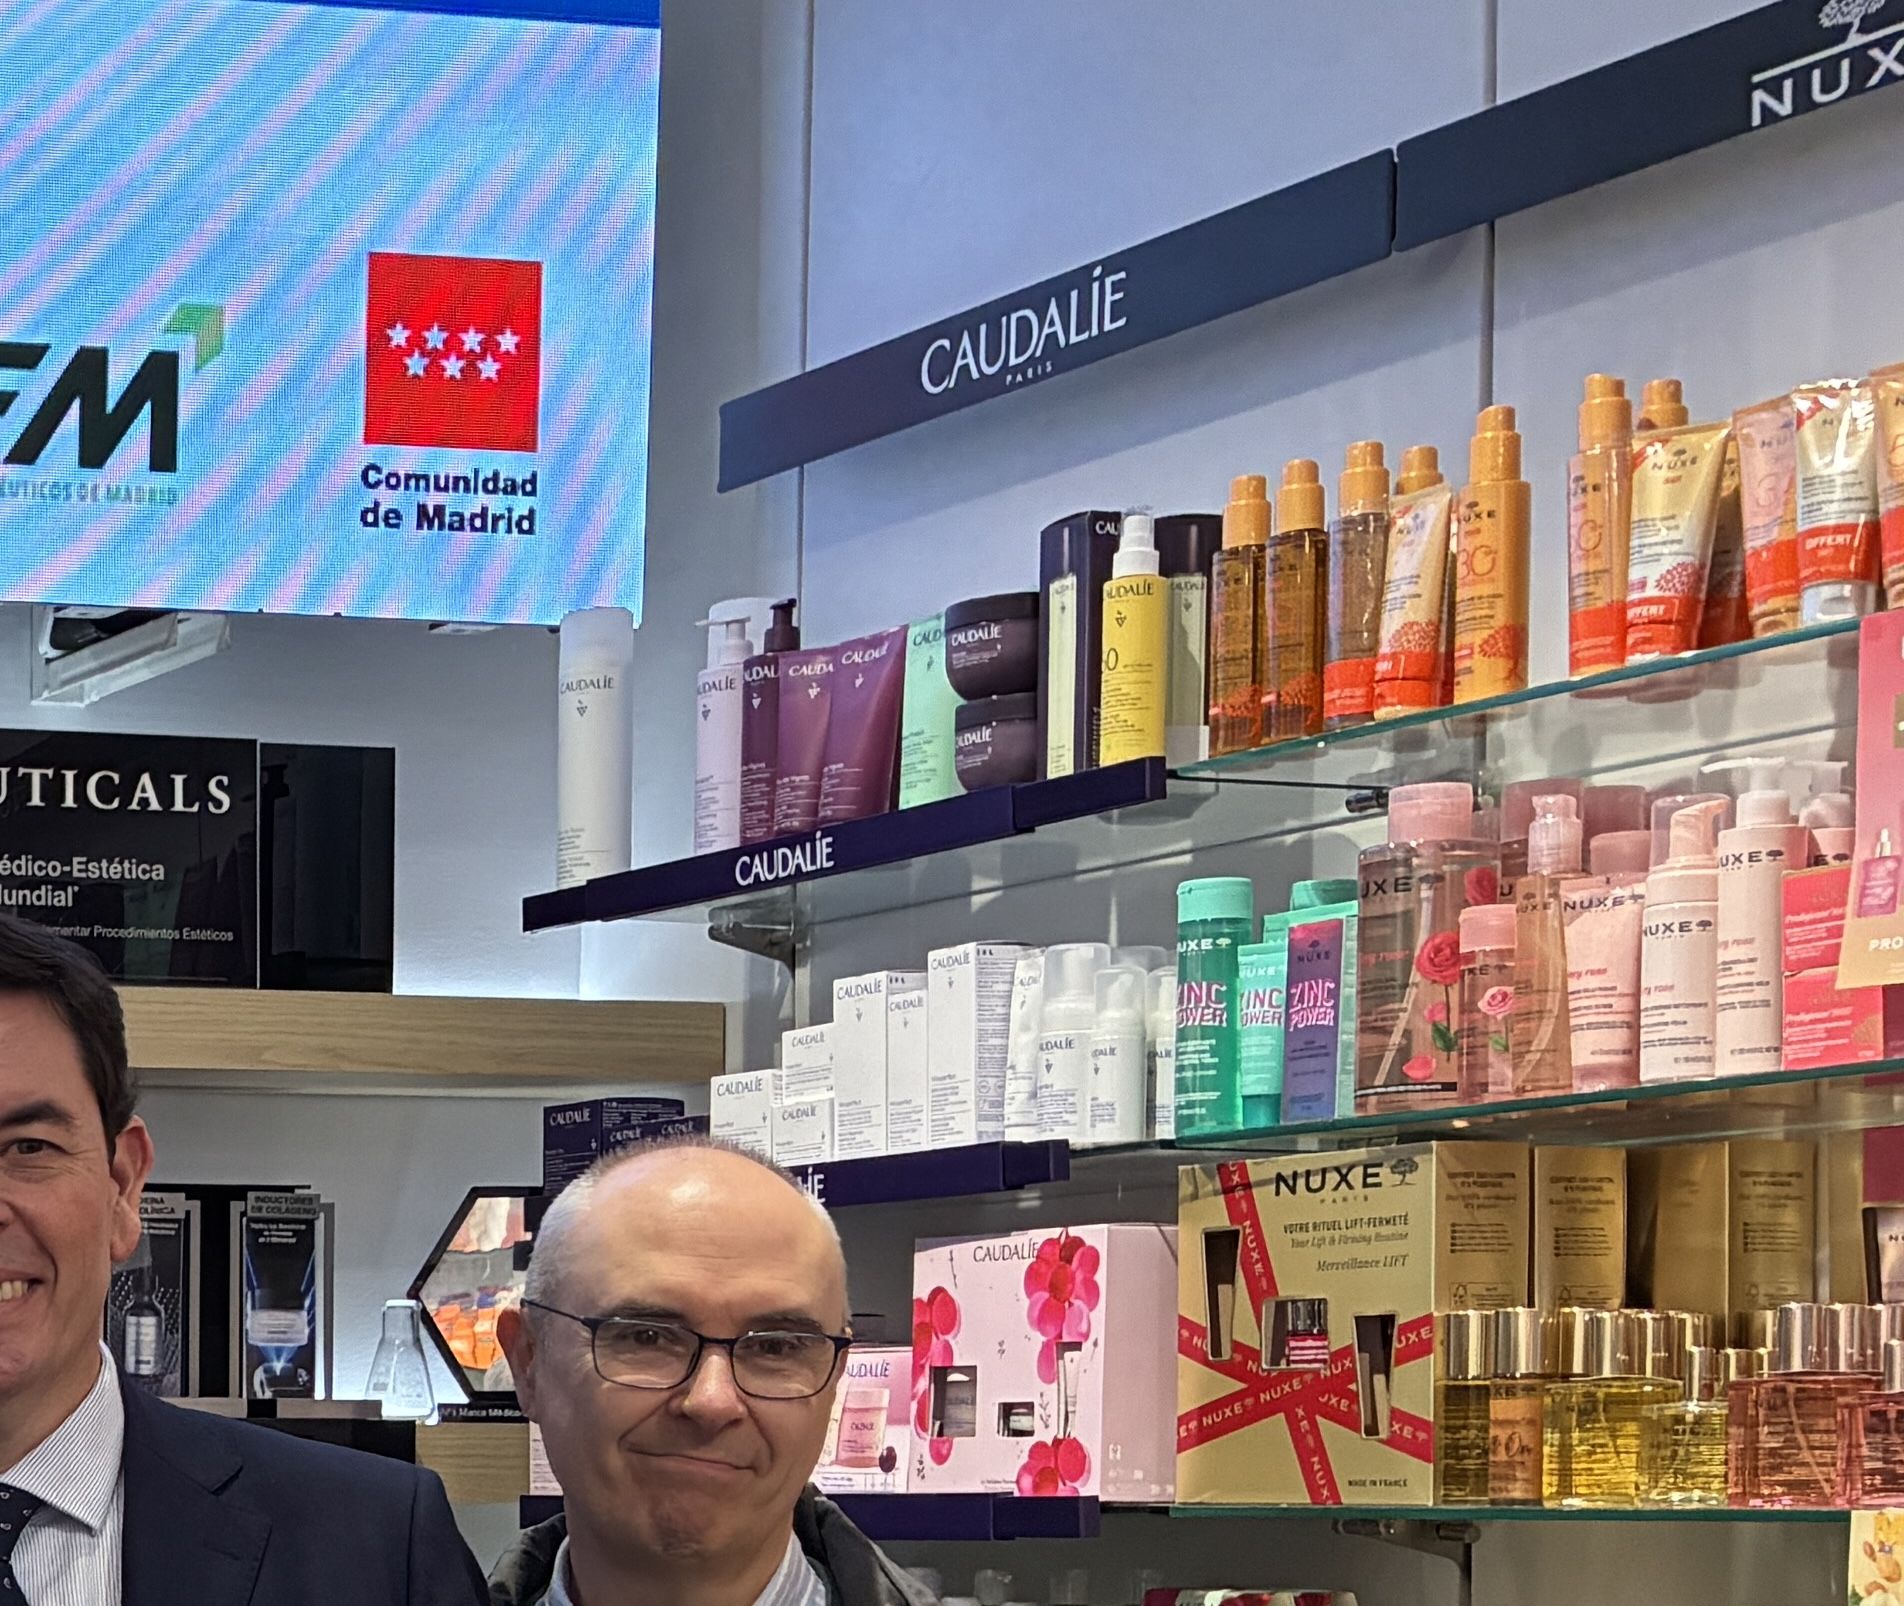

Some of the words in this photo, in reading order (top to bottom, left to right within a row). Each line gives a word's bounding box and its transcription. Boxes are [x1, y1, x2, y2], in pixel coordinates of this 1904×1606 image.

[1005, 360, 1054, 387] PARIS
[361, 463, 539, 498] Comunidad
[361, 501, 404, 531] de
[414, 502, 538, 536] Madrid
[1563, 895, 1626, 912] NUXE
[1290, 979, 1336, 1011] ZINC
[1289, 1008, 1335, 1032] POWER
[1274, 1162, 1384, 1197] NUXE
[1259, 1376, 1304, 1404] NUXE
[1202, 1404, 1243, 1427] NUXE
